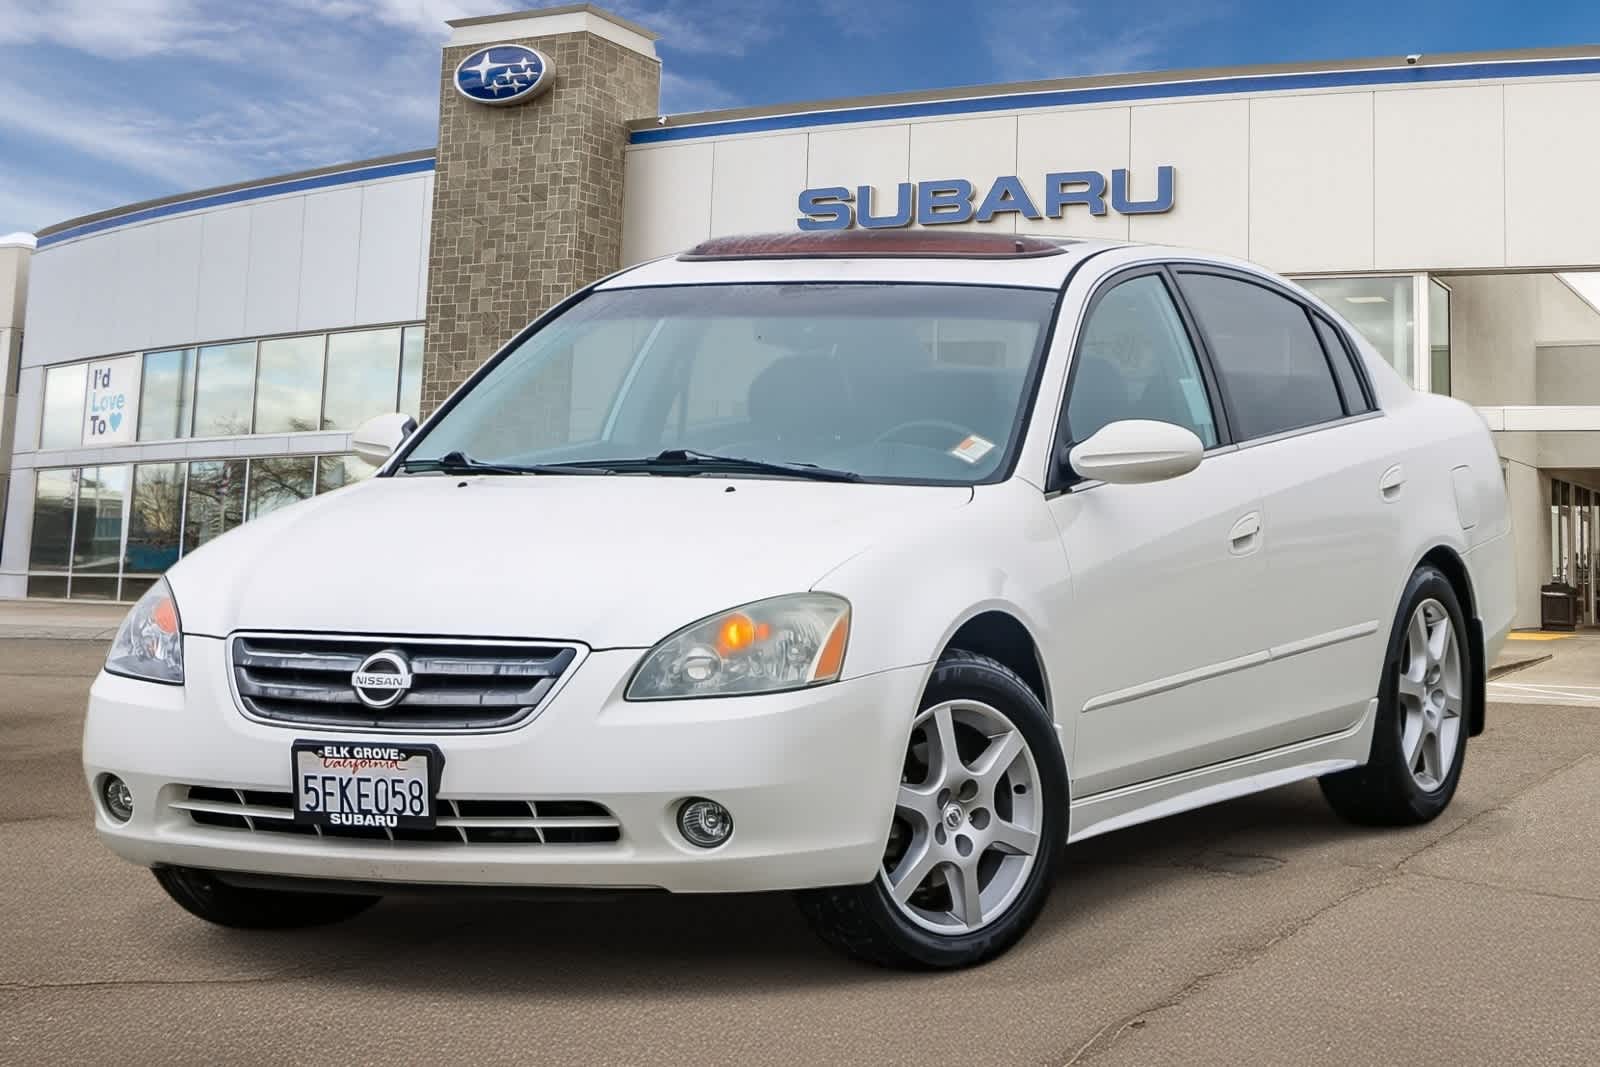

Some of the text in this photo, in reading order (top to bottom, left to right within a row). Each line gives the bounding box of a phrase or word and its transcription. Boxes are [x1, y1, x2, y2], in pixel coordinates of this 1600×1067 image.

[796, 165, 1175, 231] SUBARU
[94, 368, 111, 389] I'd
[92, 392, 125, 412] Love
[90, 415, 106, 435] To
[356, 676, 403, 686] NISSAN
[324, 746, 399, 760] ELK GROVE
[304, 775, 424, 816] 5FKE058
[330, 813, 398, 827] SUBARU
